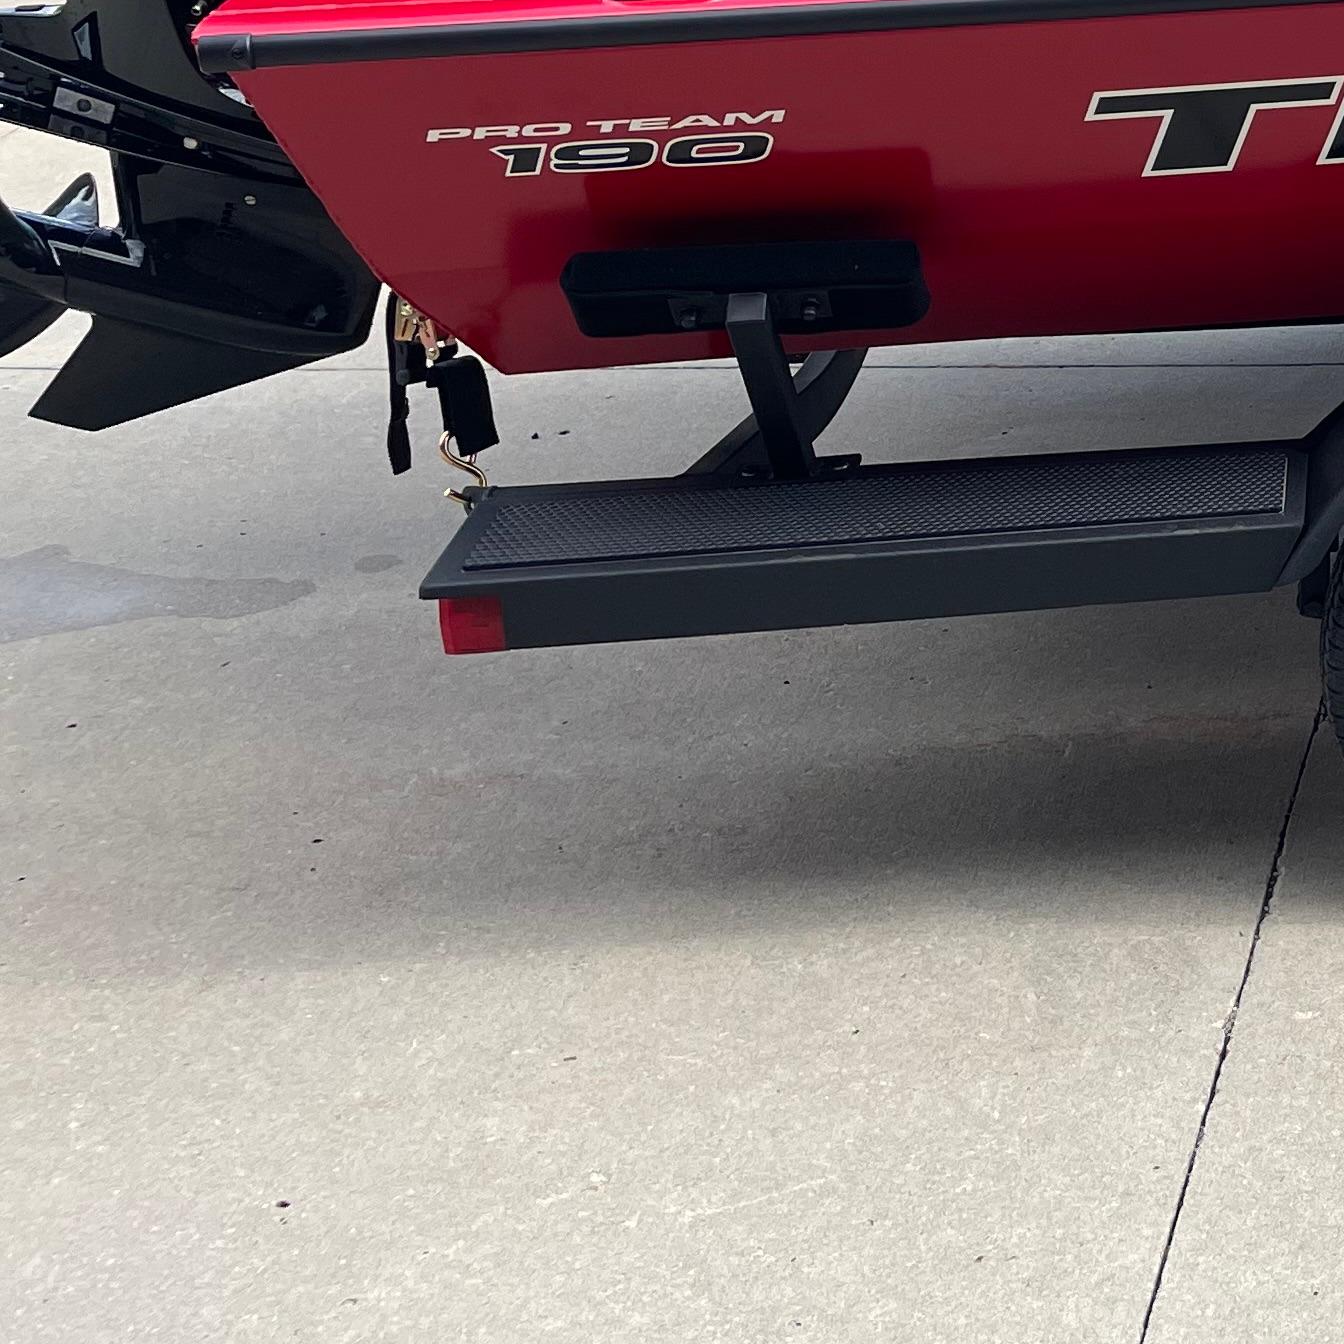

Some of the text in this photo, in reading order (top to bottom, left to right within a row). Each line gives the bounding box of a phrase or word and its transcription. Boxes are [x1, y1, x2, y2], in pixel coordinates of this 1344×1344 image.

[426, 109, 787, 143] PRO TEAM
[488, 130, 776, 178] 190
